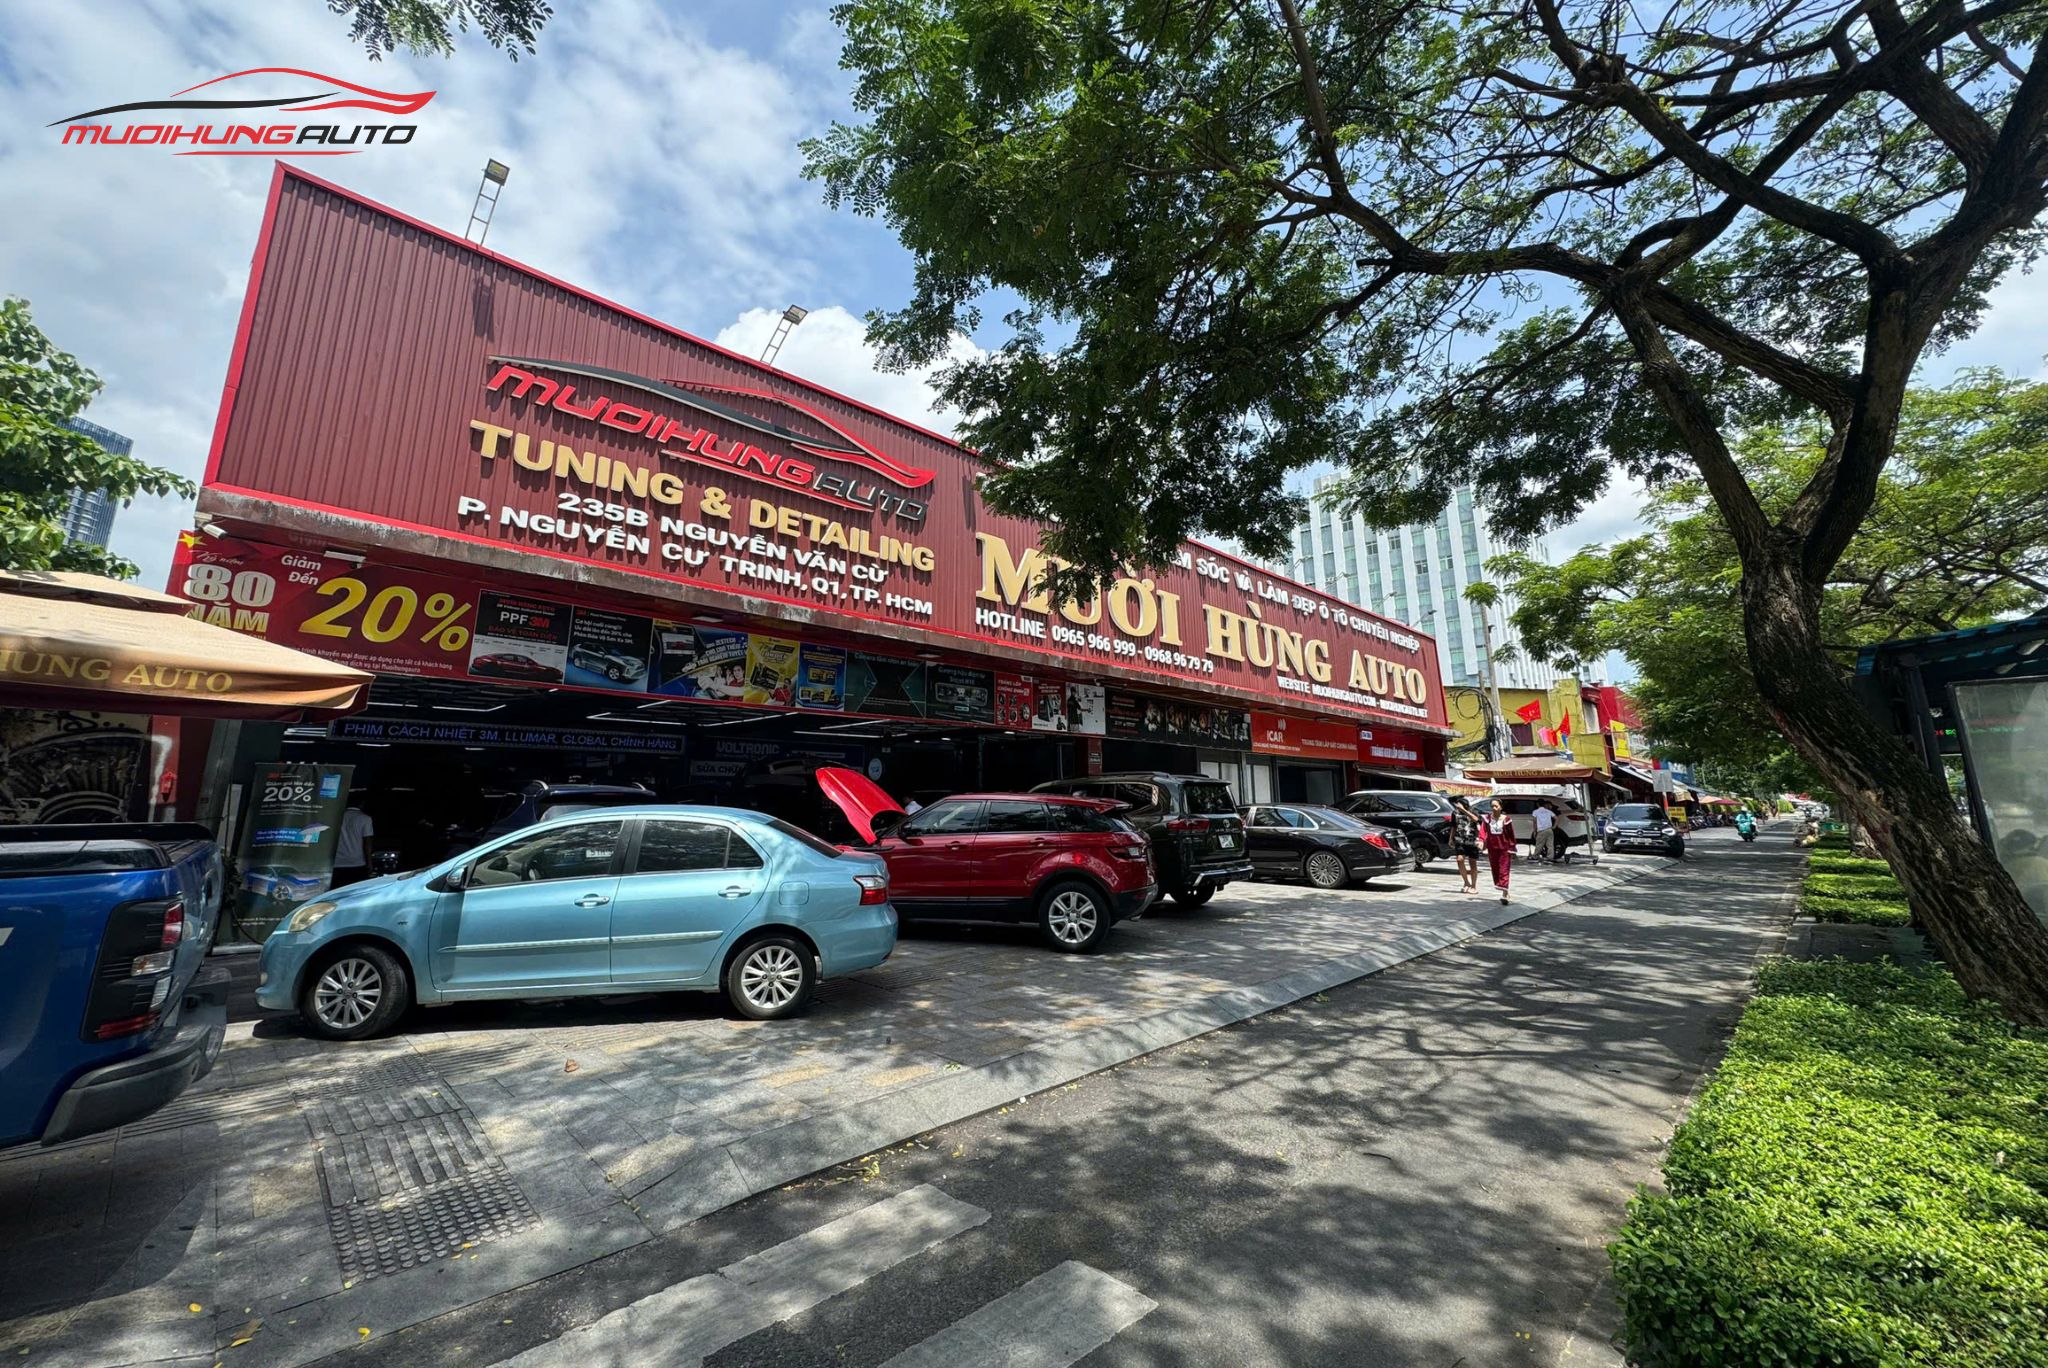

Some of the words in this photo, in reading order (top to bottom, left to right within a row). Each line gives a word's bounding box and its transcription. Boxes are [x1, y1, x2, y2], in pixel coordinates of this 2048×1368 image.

[470, 420, 684, 504] TUNING
[700, 486, 732, 519] &
[750, 498, 935, 571] DETAILING
[457, 496, 491, 521] P.
[500, 506, 650, 554] NGUYỄN
[661, 543, 710, 566] CƯ
[720, 555, 808, 591] TRINH,
[885, 592, 932, 614] HCM
[557, 493, 649, 527] 235B
[660, 516, 786, 560] NGUYỄN
[793, 549, 846, 575] VĂN
[852, 564, 889, 583] CỪ
[281, 555, 322, 571] Giảm
[288, 571, 319, 586] Đến
[183, 563, 276, 607] 80
[299, 577, 471, 651] 20%
[500, 611, 528, 625] PPF
[529, 616, 551, 628] 3M
[1196, 557, 1230, 583] SÓC
[1234, 571, 1255, 593] VÀ
[1257, 580, 1289, 605] LÀM
[1291, 594, 1316, 617] ĐẸP
[1319, 602, 1330, 619] Ô
[1331, 607, 1348, 626] TÔ
[1350, 616, 1389, 640] CHUYÊN
[1390, 634, 1420, 654] NGHIỆP
[1051, 625, 1085, 646] 0965
[1087, 633, 1111, 652] 966
[1113, 639, 1136, 656] 999
[1144, 645, 1172, 665] 0968
[1202, 600, 1332, 683] HÙNG
[1348, 650, 1427, 704] AUTO
[123, 664, 233, 692] AUTO
[1277, 676, 1310, 694] WEBSITE
[343, 723, 383, 735] PHIM
[388, 722, 431, 737] CÁCH
[561, 733, 607, 746] GLOBAL
[1266, 730, 1283, 743] ICAR
[262, 786, 314, 802] 20%
